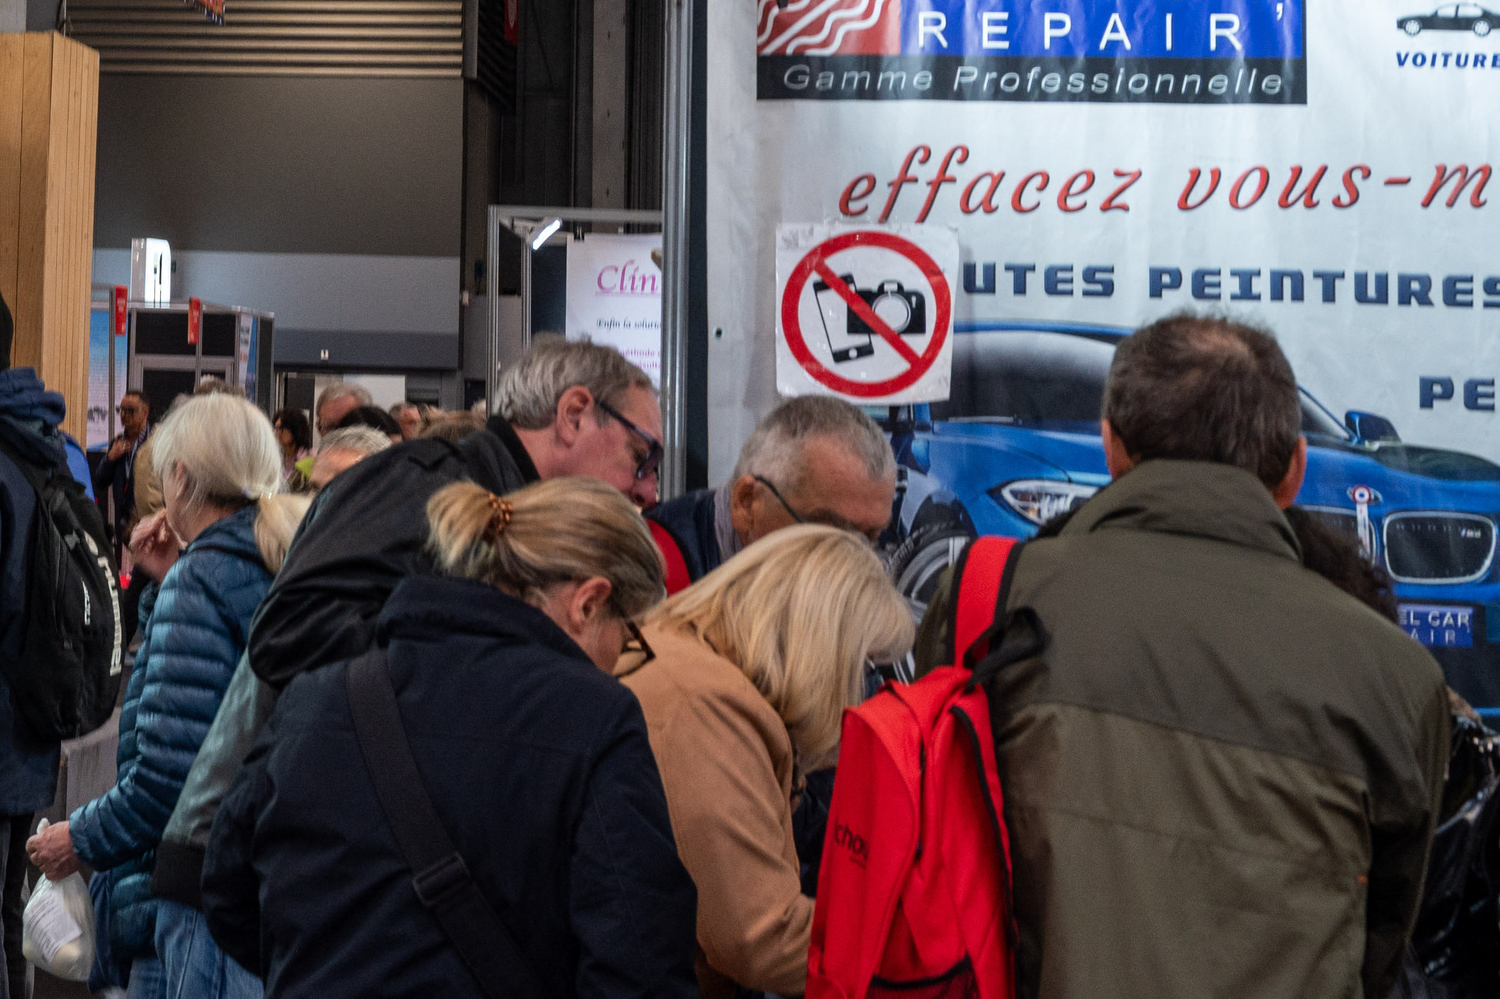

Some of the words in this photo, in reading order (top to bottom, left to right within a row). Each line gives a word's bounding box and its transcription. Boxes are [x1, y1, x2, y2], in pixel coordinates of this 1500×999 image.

[919, 12, 1243, 52] REPAIR
[783, 63, 934, 91] Gamme
[952, 65, 1284, 95] Professionnelle
[838, 143, 1143, 225] effacez
[596, 259, 659, 294] Clin
[962, 261, 1115, 297] UTES
[1148, 265, 1500, 310] PEINTURES
